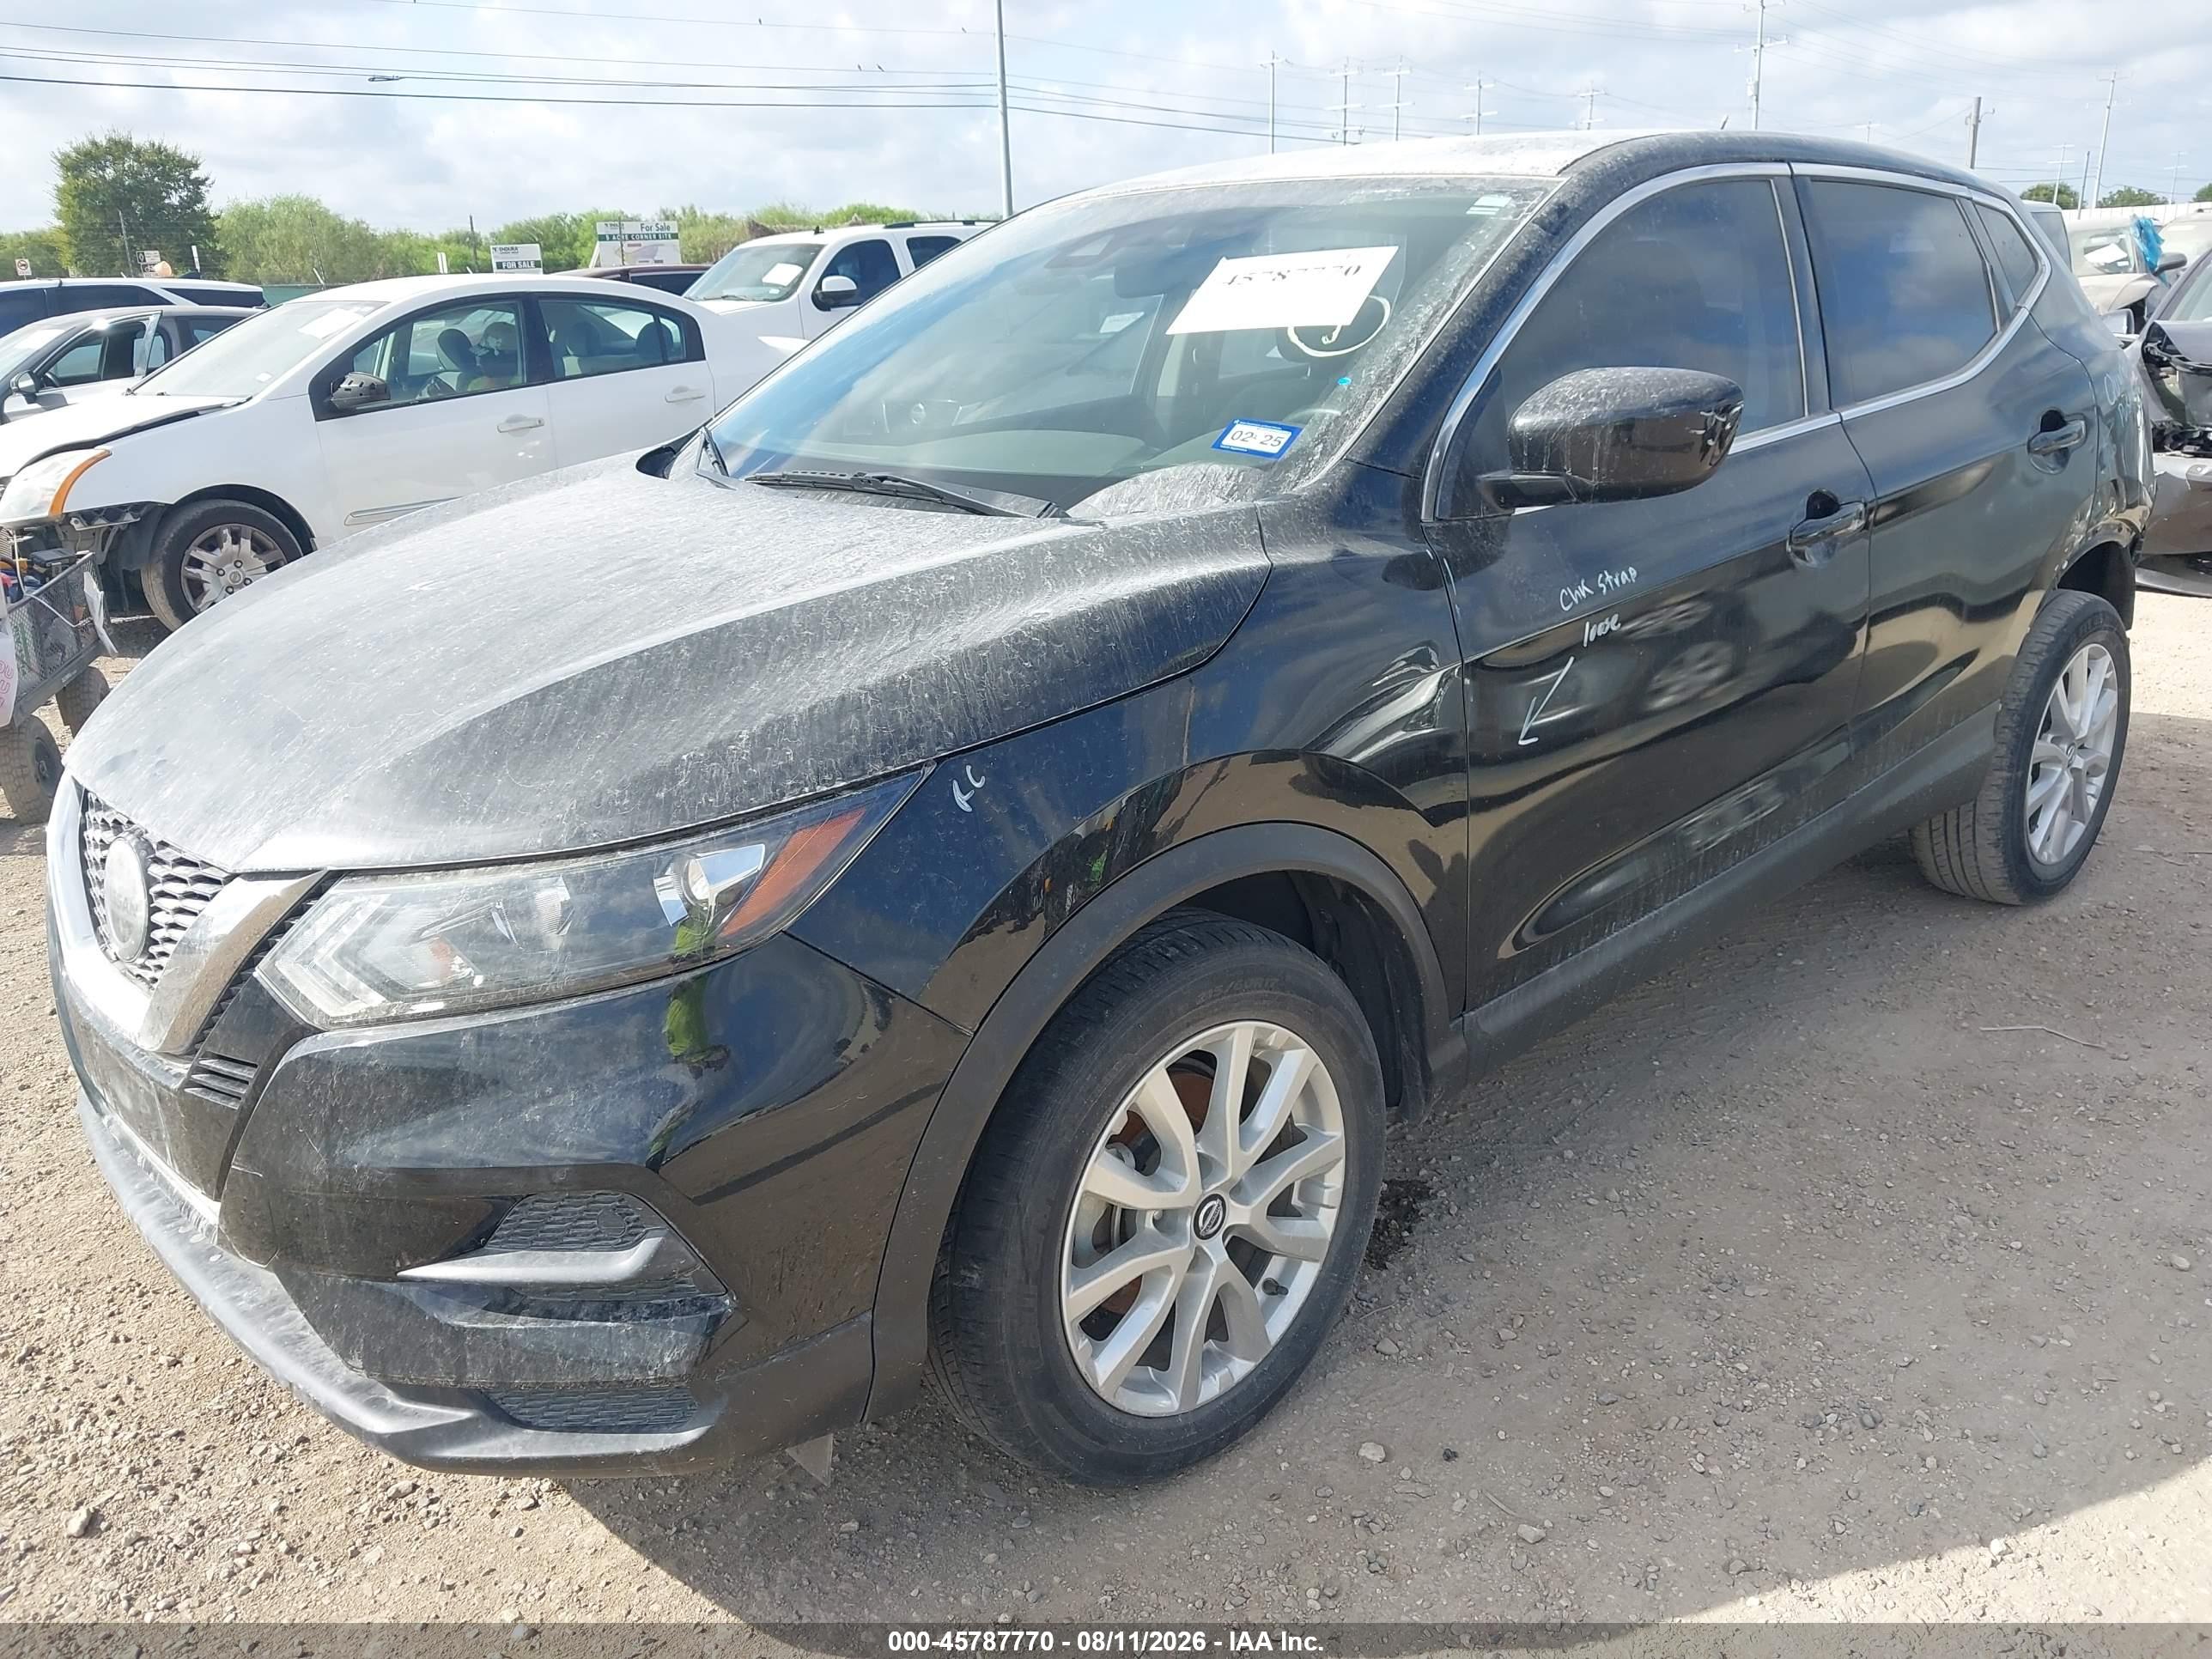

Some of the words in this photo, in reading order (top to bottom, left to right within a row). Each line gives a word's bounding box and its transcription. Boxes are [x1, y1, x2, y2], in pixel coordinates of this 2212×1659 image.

[640, 223, 653, 232] For
[655, 222, 671, 231] Sale
[518, 260, 536, 269] SALE
[1260, 434, 1285, 447] 25
